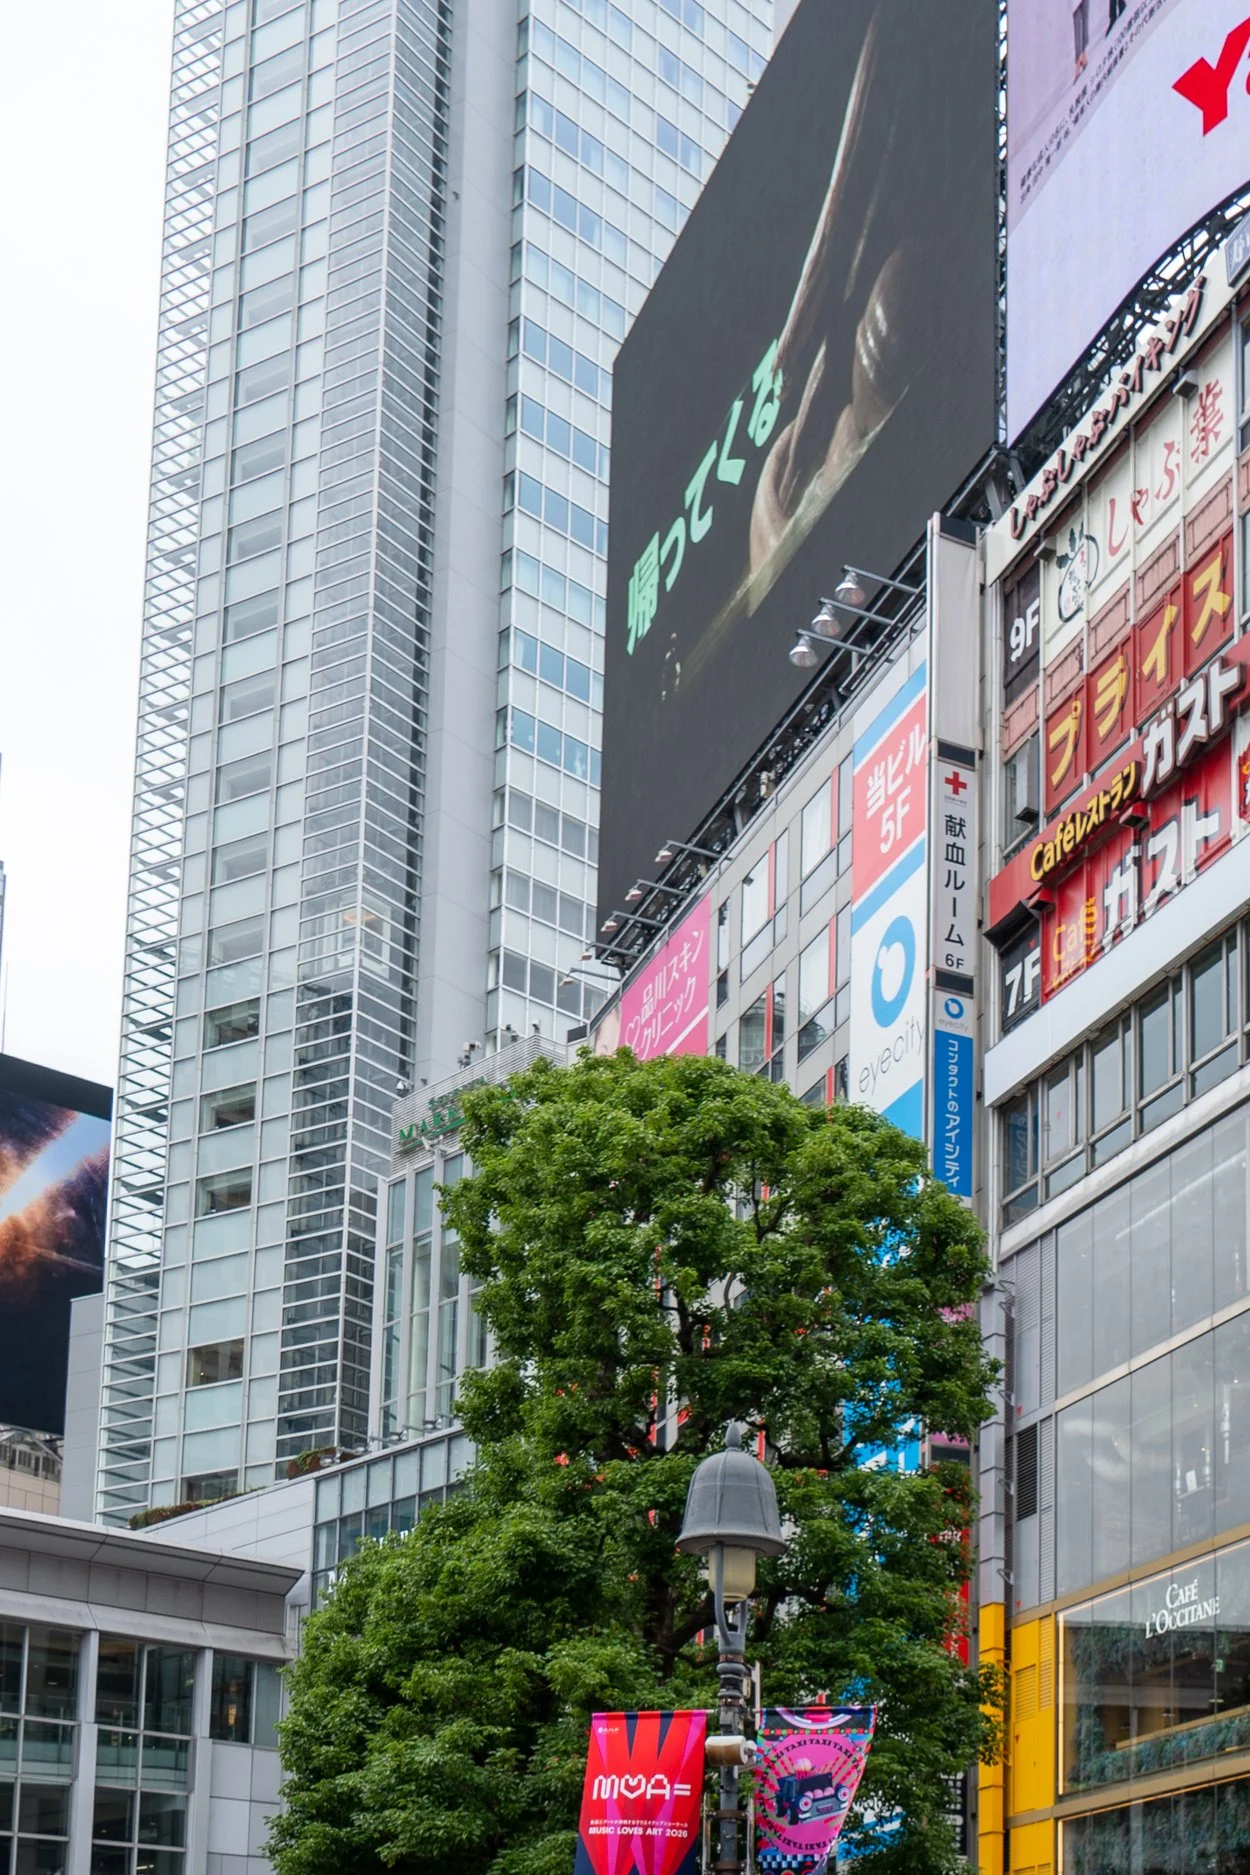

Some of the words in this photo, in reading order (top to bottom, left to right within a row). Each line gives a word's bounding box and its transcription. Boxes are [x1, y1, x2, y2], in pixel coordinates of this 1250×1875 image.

[1009, 274, 1206, 541] しゃぶしゃぶバイキング
[1108, 378, 1224, 557] しゃぶ葉
[1009, 599, 1040, 662] 9F
[1048, 550, 1231, 788] プライス
[866, 723, 926, 820] 当ビル
[1142, 656, 1244, 798] ガスト
[880, 785, 912, 854] 5F
[944, 814, 967, 947] 献血ルーム
[1101, 798, 1222, 950] ガスト
[641, 930, 705, 1025] 品川スキン
[945, 953, 965, 969] 6F
[1005, 947, 1041, 1017] 7F
[641, 976, 697, 1061] クリニック
[859, 1015, 926, 1096] eyecity
[938, 1018, 969, 1033] eyecity
[944, 1039, 961, 1188] コンタクトのアイシティ
[588, 1827, 614, 1835] MUSIC
[617, 1828, 644, 1836] LOVES
[647, 1829, 664, 1837] ART
